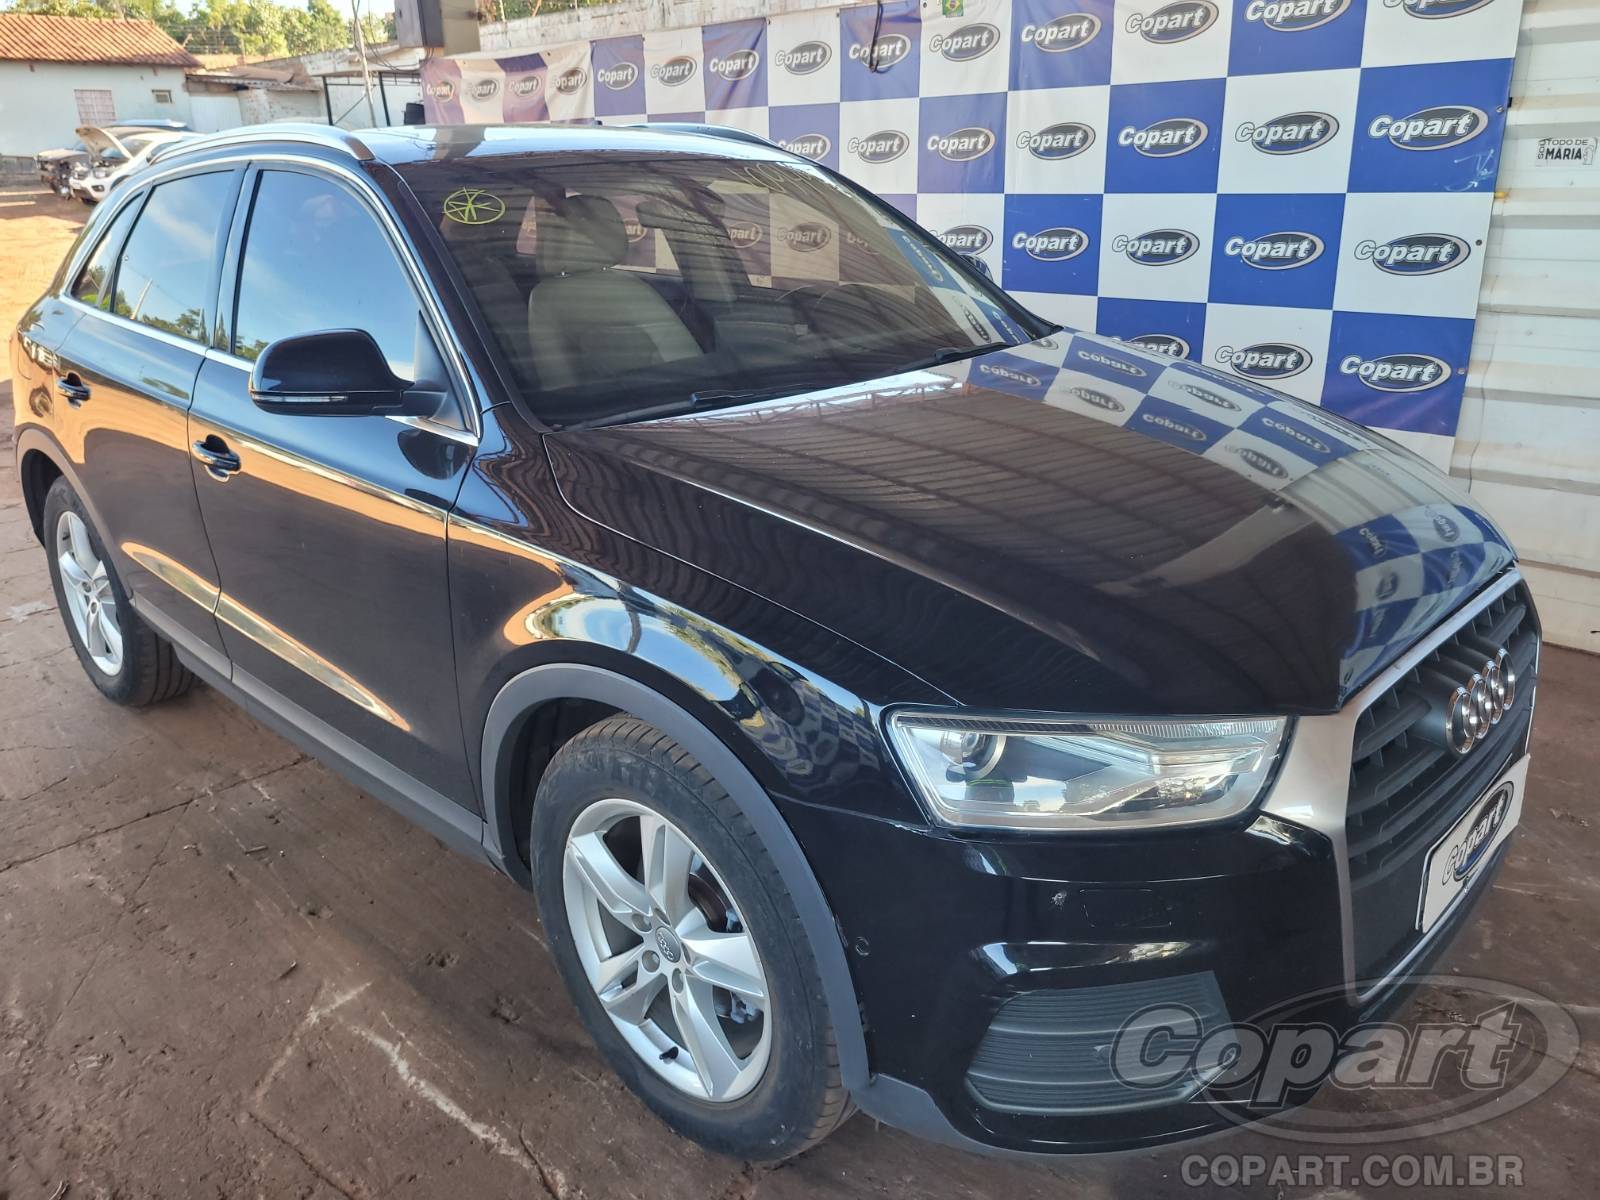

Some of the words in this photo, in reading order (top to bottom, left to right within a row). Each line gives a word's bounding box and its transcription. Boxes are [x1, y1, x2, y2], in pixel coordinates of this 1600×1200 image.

[1125, 4, 1209, 42] Copart
[1244, 0, 1334, 25] Copart
[930, 27, 990, 59] Copart
[1021, 18, 1090, 50] Copart
[651, 60, 692, 83] Copart
[709, 53, 756, 79] Copart
[776, 46, 823, 73] Copart
[597, 66, 633, 87] Copart
[1016, 125, 1083, 156] Copart
[1117, 121, 1197, 151] Copart
[1235, 115, 1322, 148] Copart
[1367, 110, 1475, 142] Copart
[848, 135, 901, 158] Copart
[927, 129, 987, 157] Copart
[1545, 147, 1582, 160] MARIA
[1546, 138, 1573, 146] TODO
[1011, 229, 1079, 255] Copart
[1112, 233, 1188, 262] Copart
[1224, 234, 1312, 265] Copart
[1354, 238, 1455, 268] Copart
[1214, 344, 1299, 374] Copart
[1340, 354, 1440, 385] Copart
[1442, 790, 1507, 885] Copart
